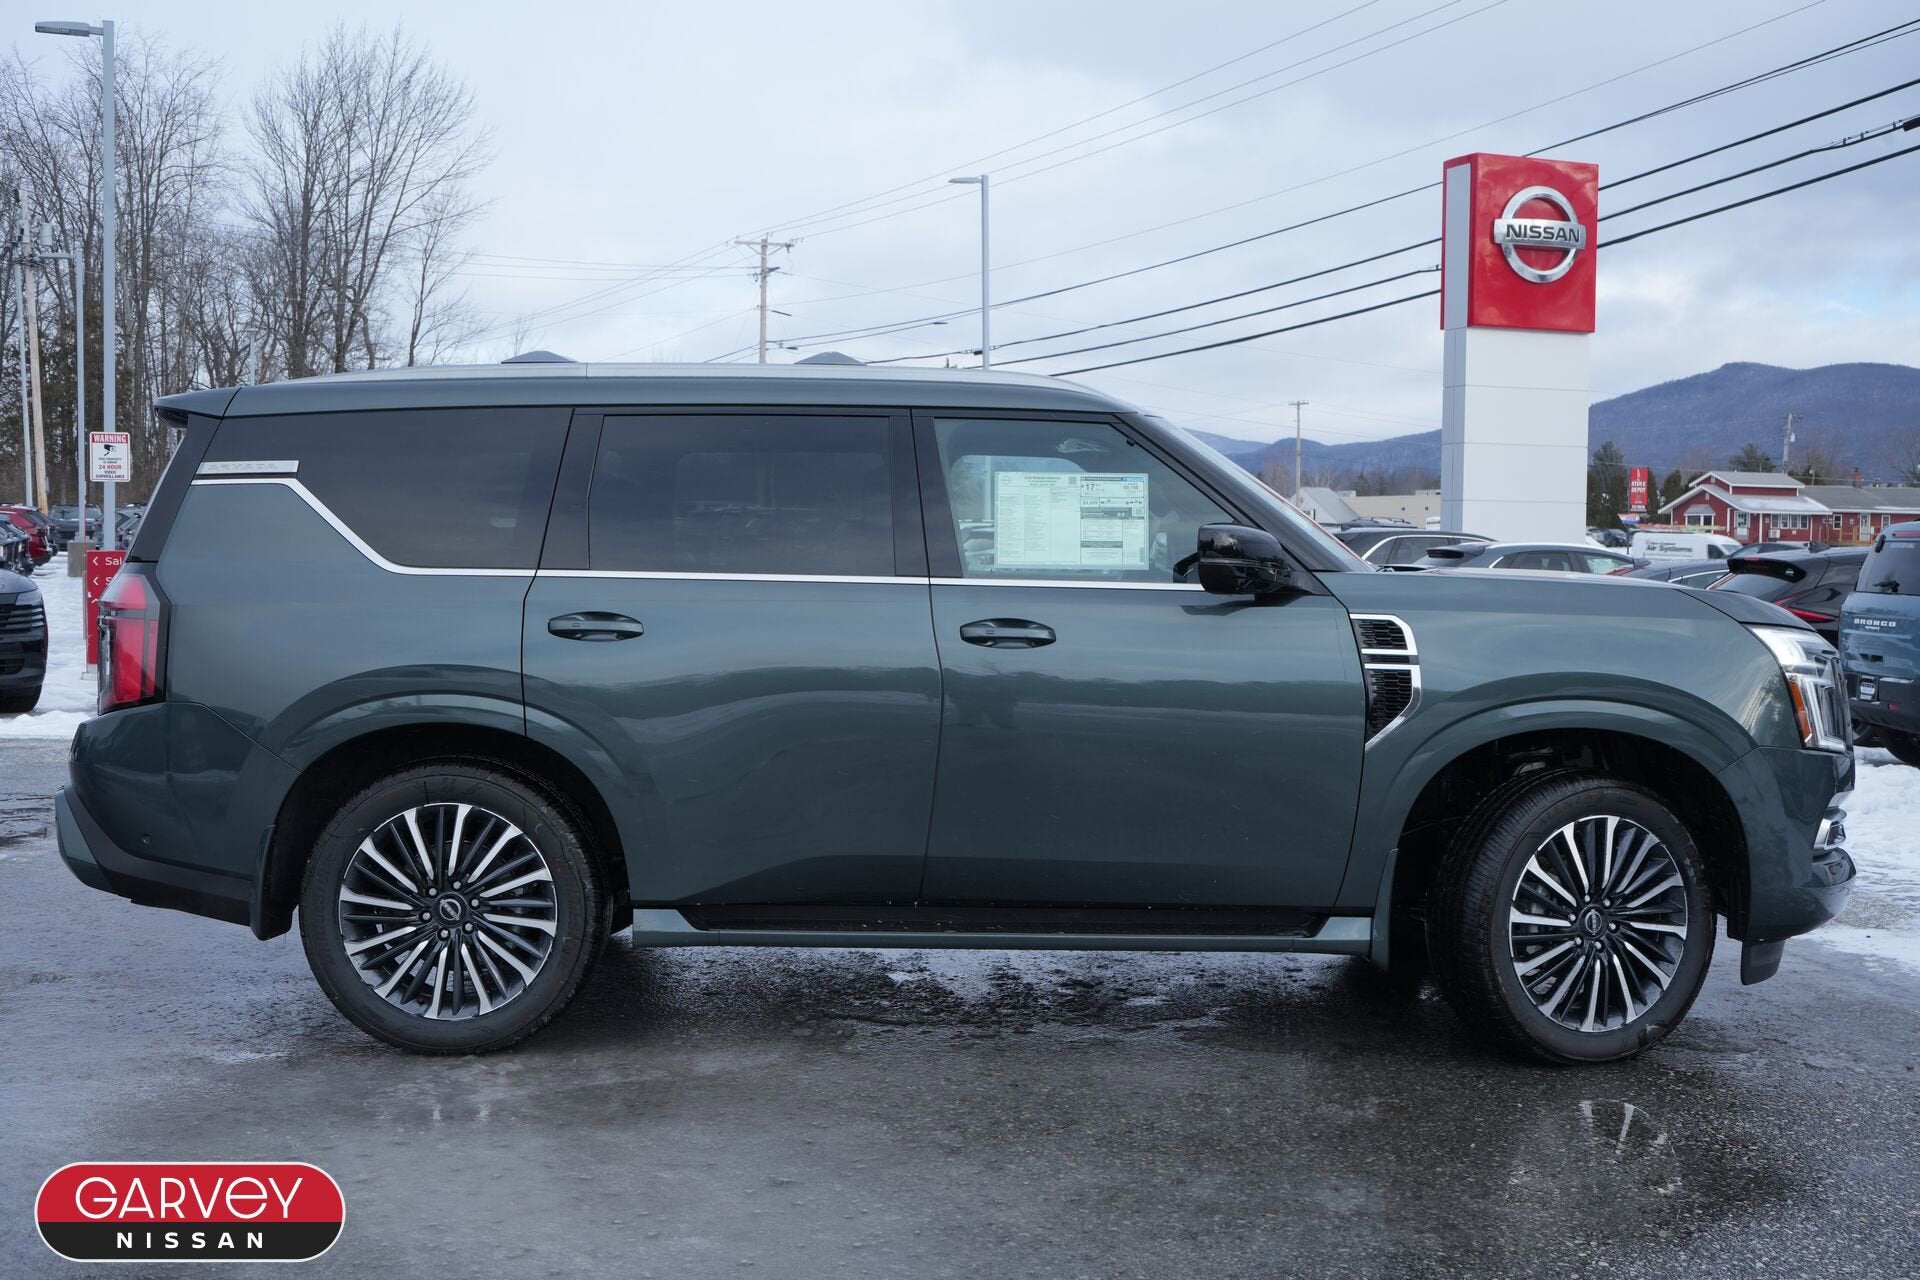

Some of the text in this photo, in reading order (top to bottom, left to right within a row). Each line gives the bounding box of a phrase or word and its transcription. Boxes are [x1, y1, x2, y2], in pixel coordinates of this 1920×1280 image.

[1506, 224, 1580, 243] NISSAN
[94, 434, 127, 443] WARNING
[105, 556, 125, 566] Sal
[1853, 618, 1897, 628] BRONCO
